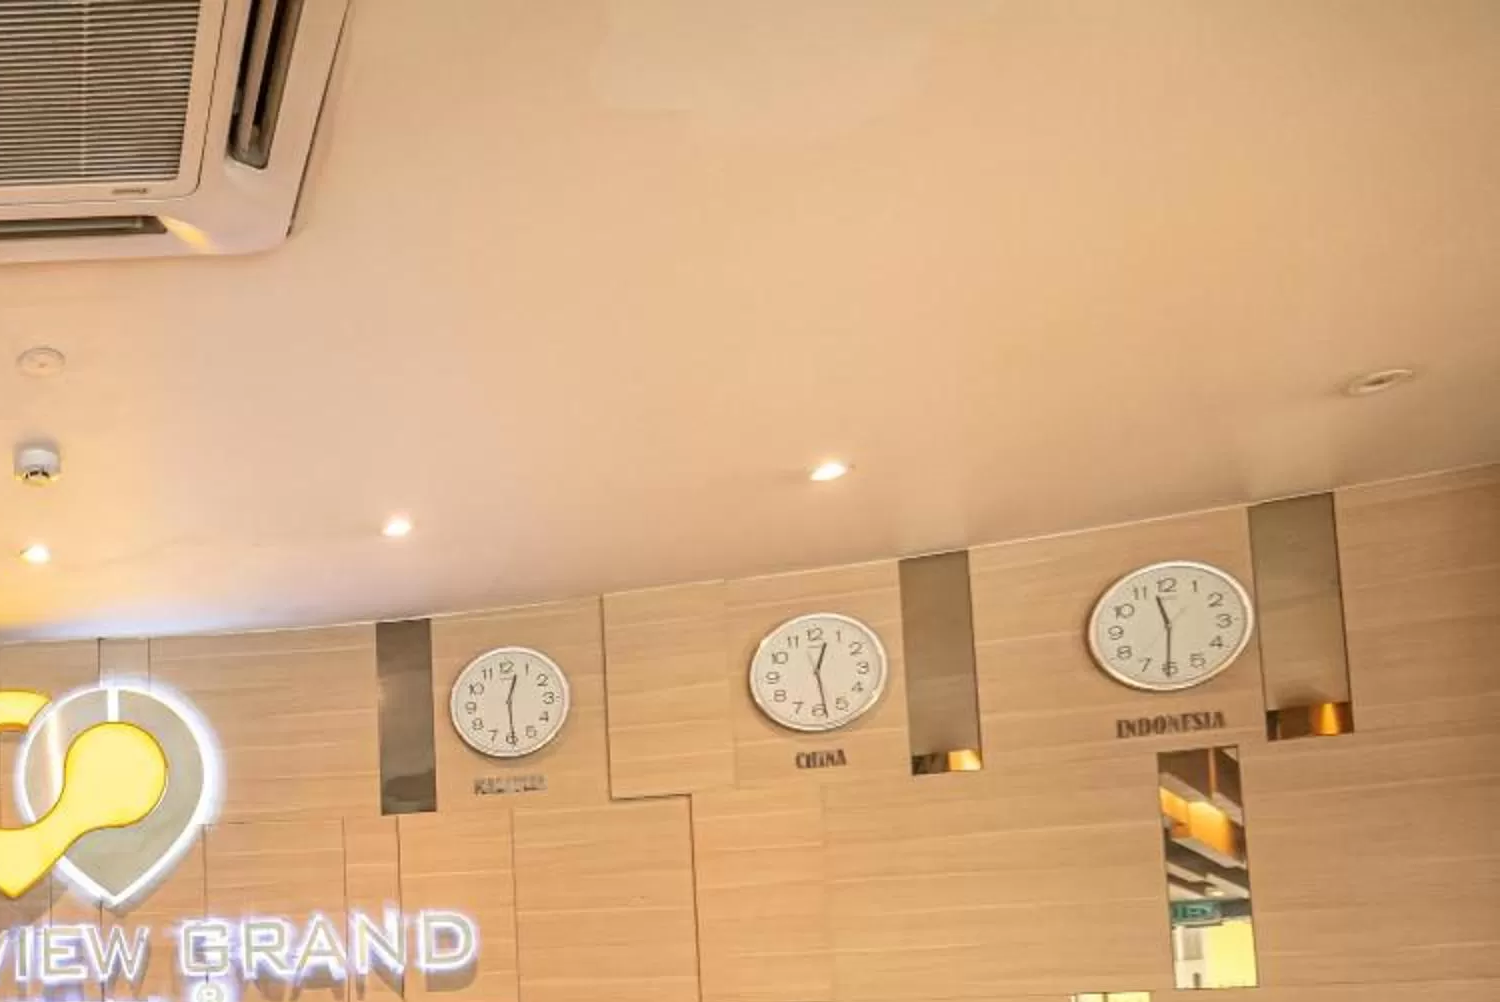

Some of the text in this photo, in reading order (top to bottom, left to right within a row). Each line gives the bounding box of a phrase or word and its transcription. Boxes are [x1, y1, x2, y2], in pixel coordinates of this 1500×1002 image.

[1157, 578, 1177, 592] 12
[1133, 586, 1147, 599] 11
[1208, 592, 1223, 608] 2
[1114, 603, 1135, 619] 10
[1216, 613, 1232, 628] 3
[806, 628, 823, 641] 12
[1108, 626, 1124, 640] 9
[788, 636, 799, 648] 11
[1209, 636, 1223, 648] 4
[849, 642, 863, 656] 2
[1117, 646, 1132, 660] 8
[771, 651, 788, 664] 10
[1190, 653, 1206, 668] 5
[500, 661, 514, 674] 12
[856, 662, 869, 674] 3
[1139, 658, 1151, 672] 7
[482, 668, 492, 680] 11
[537, 674, 548, 686] 2
[765, 672, 780, 684] 9
[469, 683, 484, 695] 10
[852, 682, 863, 691] 4
[542, 692, 555, 704] 3
[774, 690, 787, 702] 8
[466, 702, 476, 714] 9
[792, 701, 804, 714] 7
[836, 697, 849, 711] 5
[539, 711, 548, 722] 4
[472, 718, 484, 730] 8
[1116, 712, 1226, 738] INDONESIA
[488, 729, 498, 741] 7
[526, 726, 537, 738] 5
[795, 749, 847, 768] CHINA
[180, 909, 476, 978] GRAND
